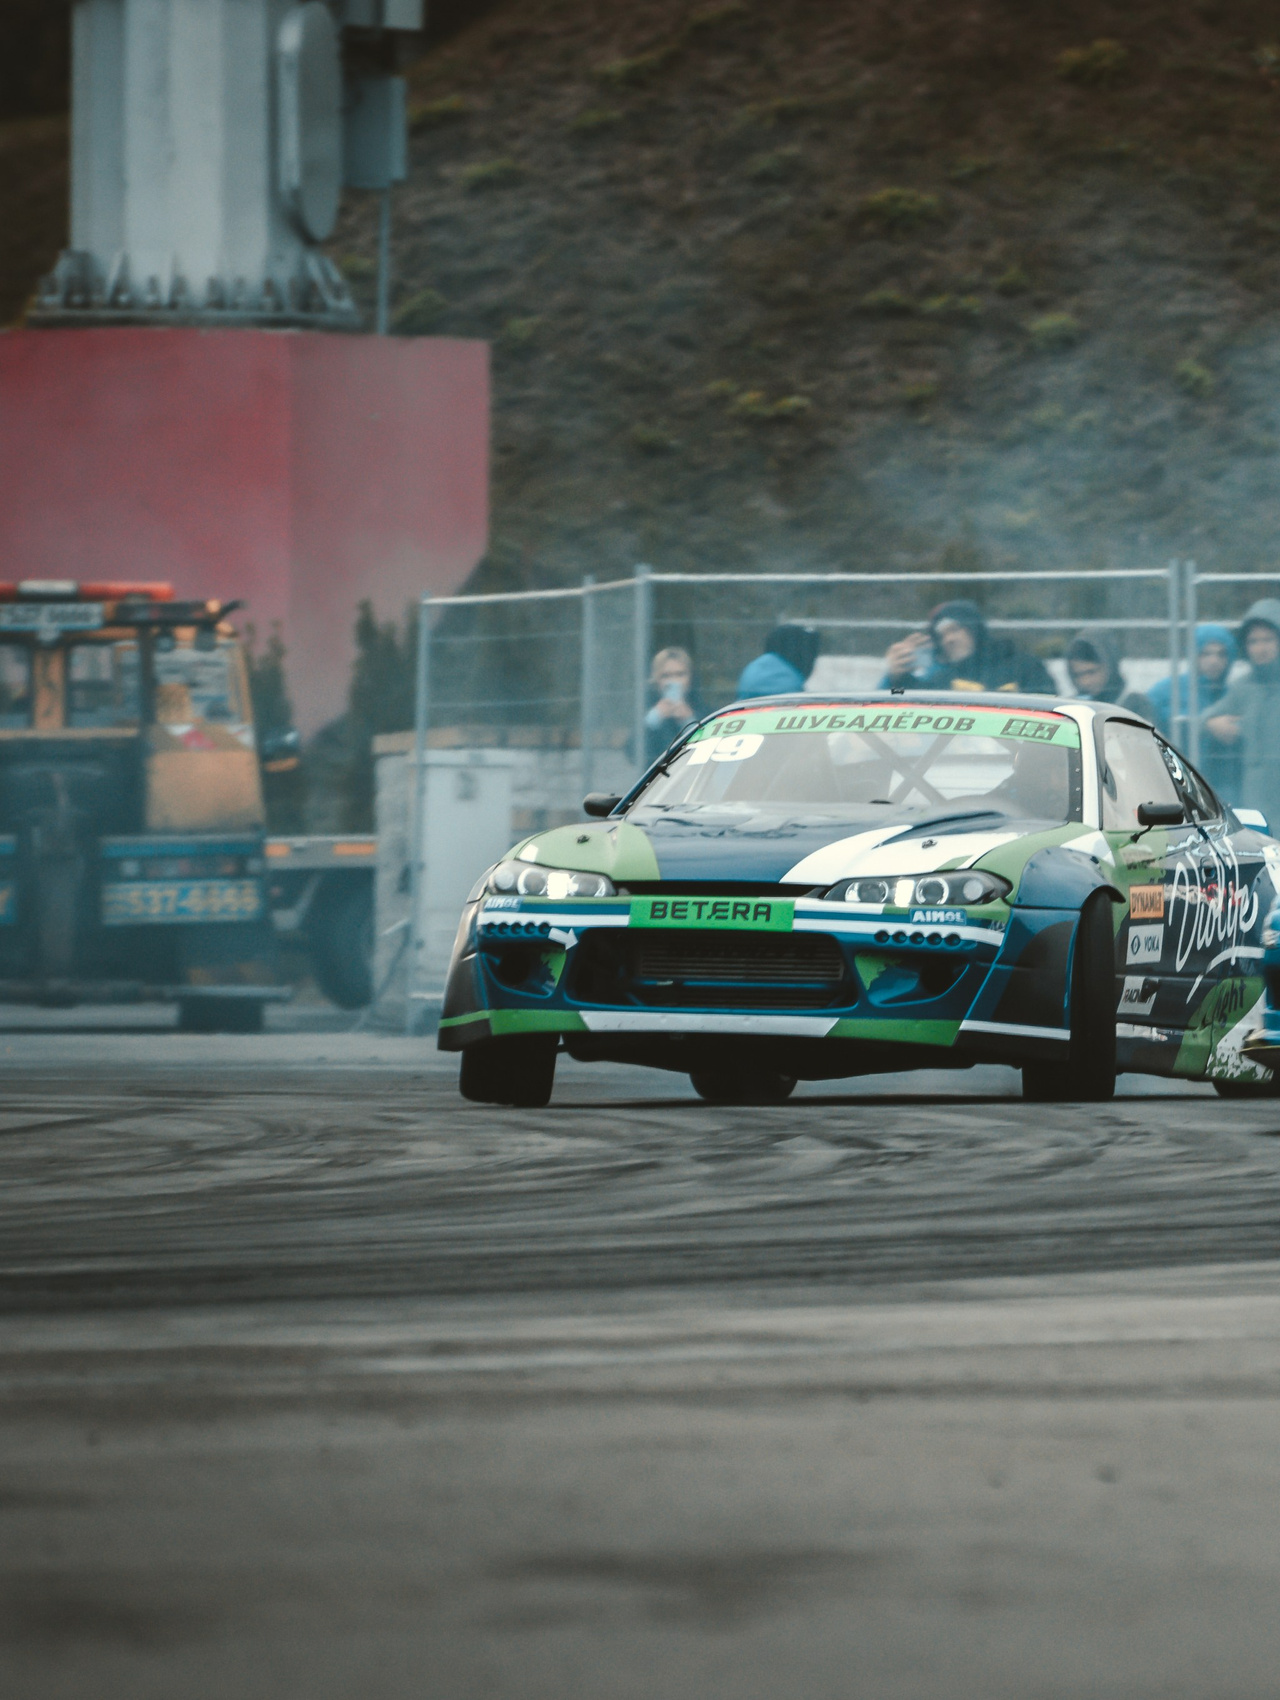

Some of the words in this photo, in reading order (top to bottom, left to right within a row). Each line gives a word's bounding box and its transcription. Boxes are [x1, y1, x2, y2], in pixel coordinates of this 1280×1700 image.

[711, 719, 747, 736] 19
[774, 711, 976, 734] ШУБАДЁРОВ
[686, 734, 765, 766] 19
